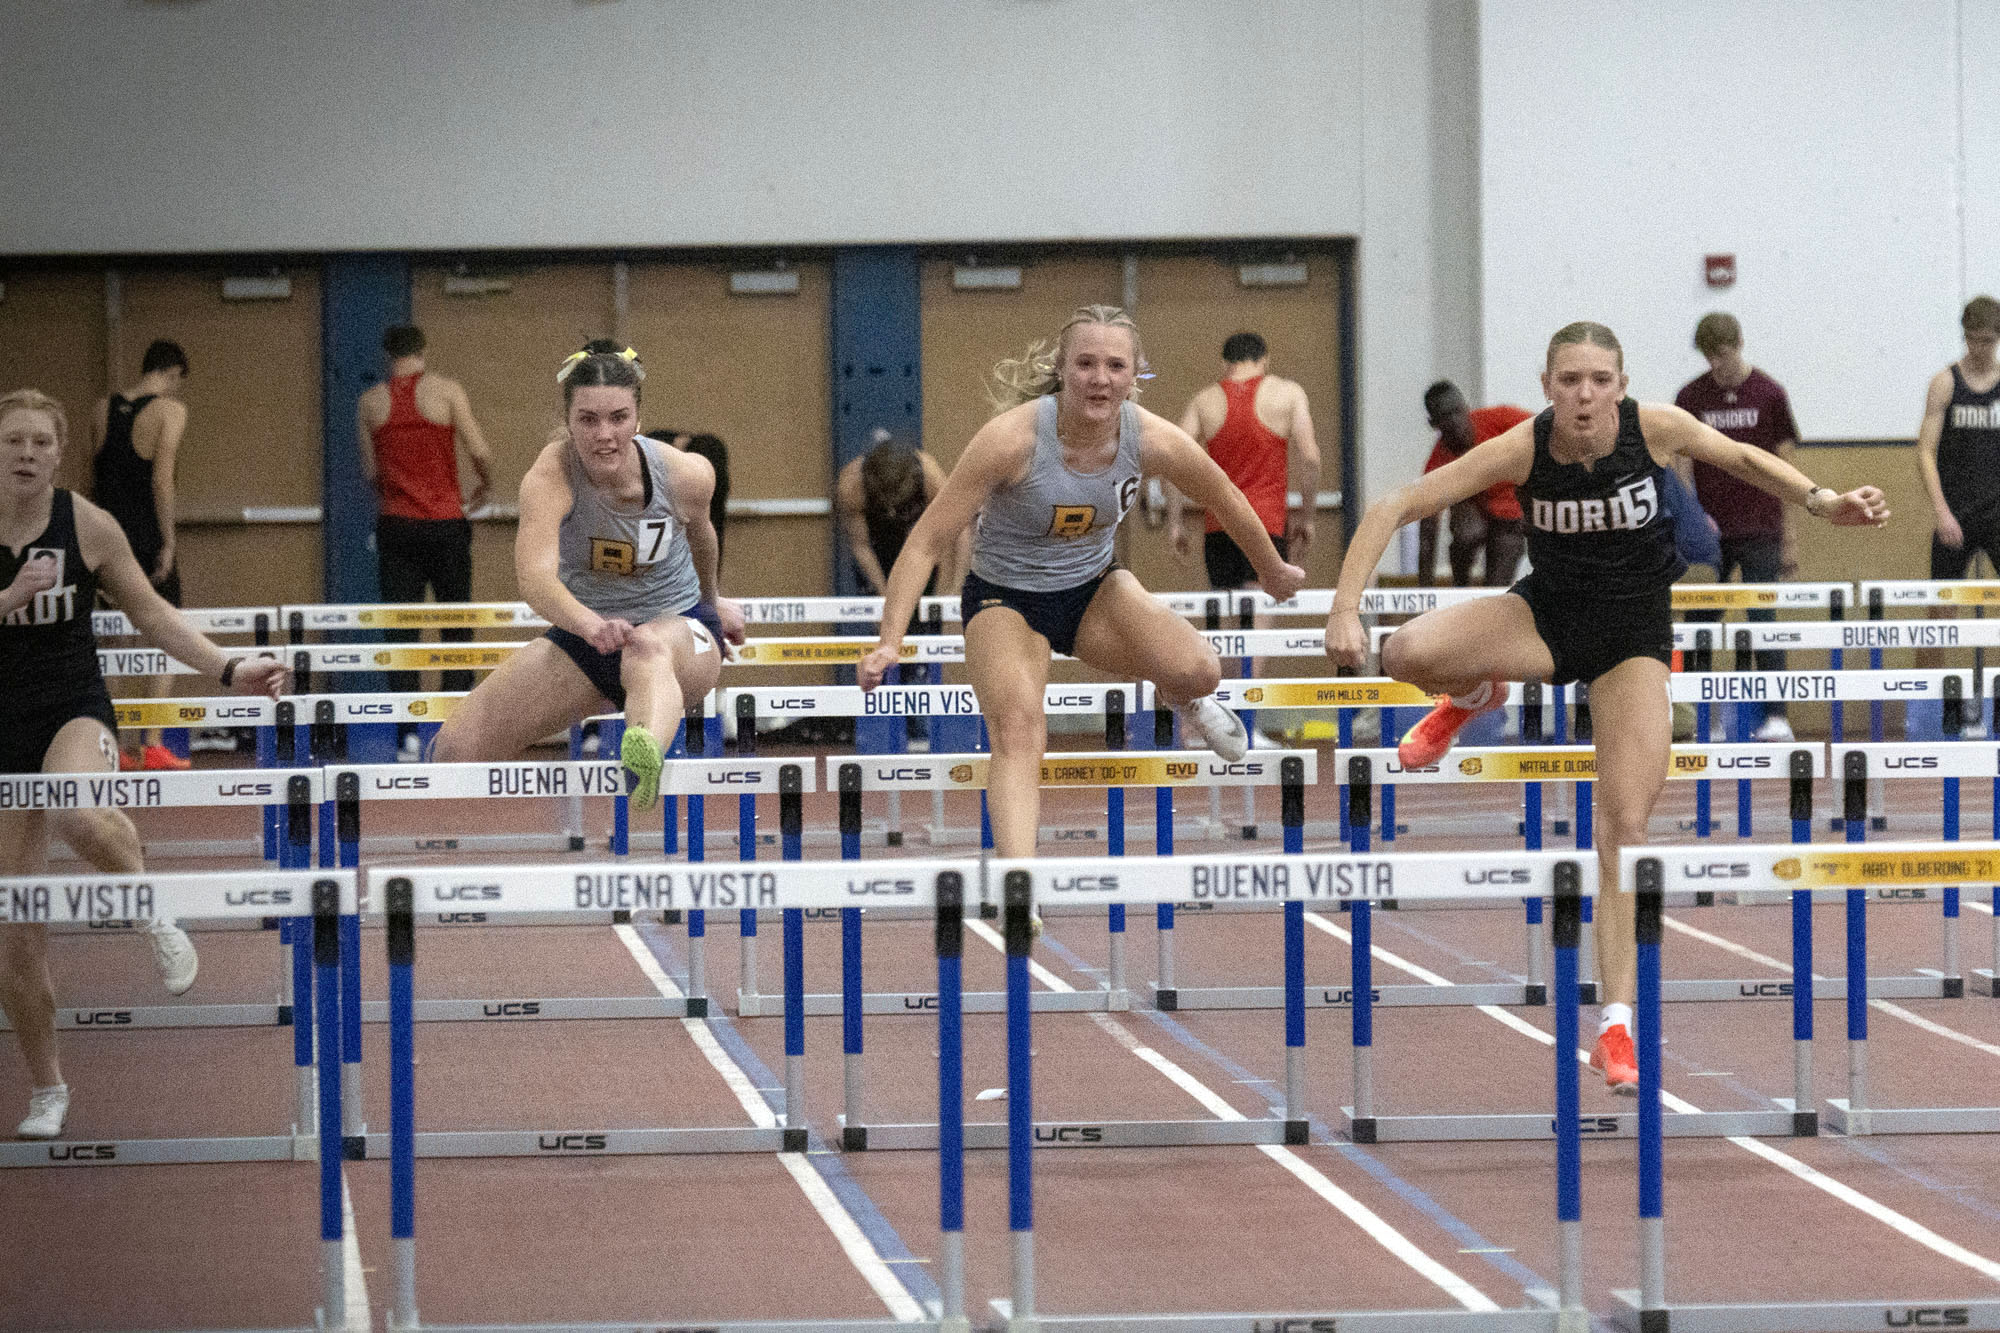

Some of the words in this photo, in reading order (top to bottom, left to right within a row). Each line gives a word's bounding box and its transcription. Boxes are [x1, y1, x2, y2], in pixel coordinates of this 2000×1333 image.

[1629, 484, 1651, 525] 5
[647, 522, 666, 561] 7
[759, 602, 805, 622] VISTA
[1762, 632, 1801, 643] UCS
[1842, 627, 1899, 648] BUENA
[1907, 625, 1959, 648] VISTA
[115, 654, 167, 673] VISTA
[321, 653, 361, 665] UCS
[1701, 677, 1766, 701] BUENA
[1776, 675, 1835, 699] VISTA
[1882, 681, 1927, 692] UCS
[1047, 696, 1093, 707] UCS
[1317, 690, 1335, 701] AVA
[1338, 690, 1362, 701] MILLS
[347, 704, 393, 716] UCS
[770, 699, 816, 710] UCS
[864, 692, 931, 715] BUENA
[940, 691, 974, 714] VIS
[216, 708, 261, 719] UCS
[1166, 763, 1198, 776] BVU
[1210, 763, 1263, 776] UCS
[1518, 761, 1561, 774] NATALIE
[1563, 759, 1598, 773] OLORU
[1674, 757, 1708, 769] BVU
[1717, 756, 1771, 769] UCS
[1884, 756, 1938, 769] UCS
[706, 771, 761, 784] UCS
[877, 768, 931, 781] UCS
[1054, 766, 1096, 780] CARNEY
[375, 777, 430, 790] UCS
[488, 768, 566, 800] BUENA
[578, 766, 619, 796] VIS
[0, 780, 78, 808] BUENA
[89, 778, 161, 807] VISTA
[217, 784, 272, 797] UCS
[1464, 868, 1531, 884] UCS
[1683, 861, 1750, 878] UCS
[847, 878, 915, 895] UCS
[1052, 874, 1120, 891] UCS
[1192, 864, 1289, 899] BUENA
[1304, 862, 1394, 897] VISTA
[225, 889, 293, 906] UCS
[434, 883, 502, 901] UCS
[574, 875, 673, 909] BUENA
[687, 872, 776, 907] VISTA
[1878, 889, 1926, 899] UCS
[64, 882, 154, 919] VISTA
[438, 912, 487, 923] UCS
[1740, 984, 1794, 997] UCS
[483, 1002, 540, 1016] UCS
[904, 997, 939, 1009] UC
[75, 1012, 132, 1025] UCS
[1035, 1127, 1102, 1142] UCS
[538, 1135, 606, 1150] UCS
[48, 1145, 116, 1160] UCS
[1884, 1307, 1968, 1327] UCS
